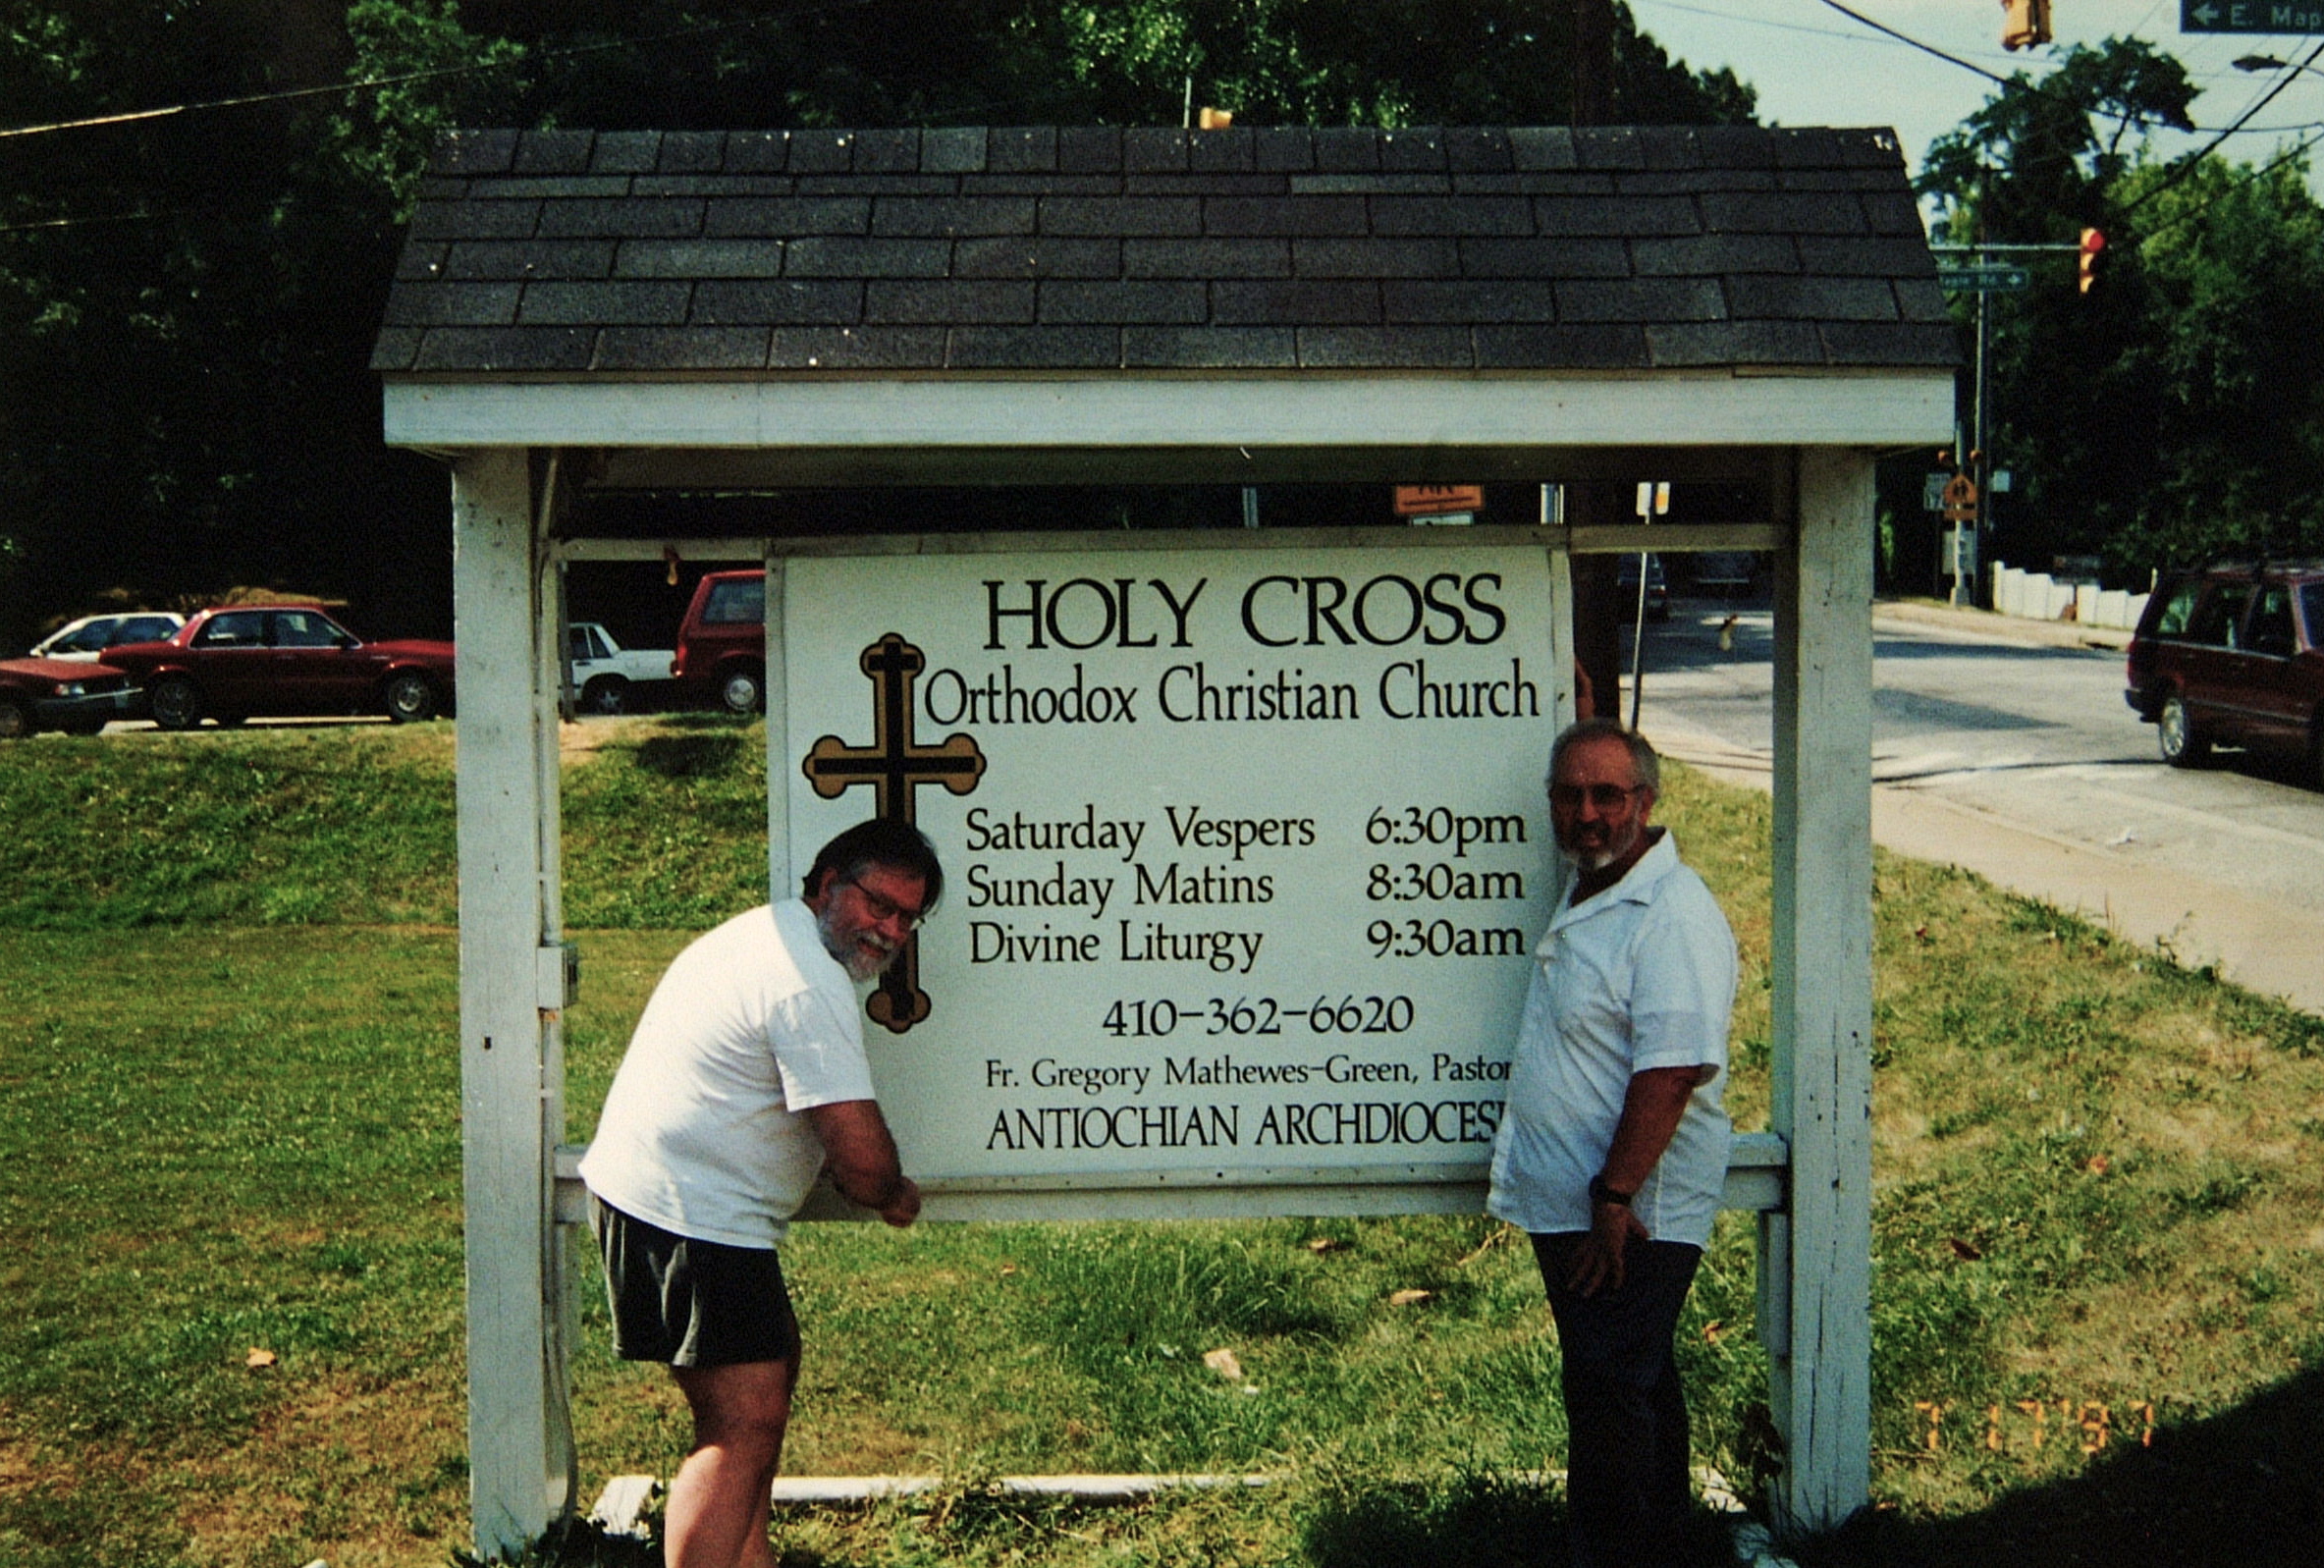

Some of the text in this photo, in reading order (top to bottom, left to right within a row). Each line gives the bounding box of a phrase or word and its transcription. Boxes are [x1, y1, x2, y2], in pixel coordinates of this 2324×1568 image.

[2230, 4, 2254, 27] E.
[982, 573, 1507, 651] HOLY CROSS
[924, 658, 1540, 726] Orthodox Christian Church
[967, 804, 1528, 862] Saturday Vespers 6:30pm
[968, 861, 1526, 920] Sunday Matins 8:30am
[970, 919, 1527, 975] Divine Liturgy 9:30am
[1103, 995, 1415, 1037] 410-362-6620
[986, 1053, 1511, 1095] Fr. Gregory Mathewes-Green, Pastor
[987, 1106, 1239, 1151] ANTIOCHIAN
